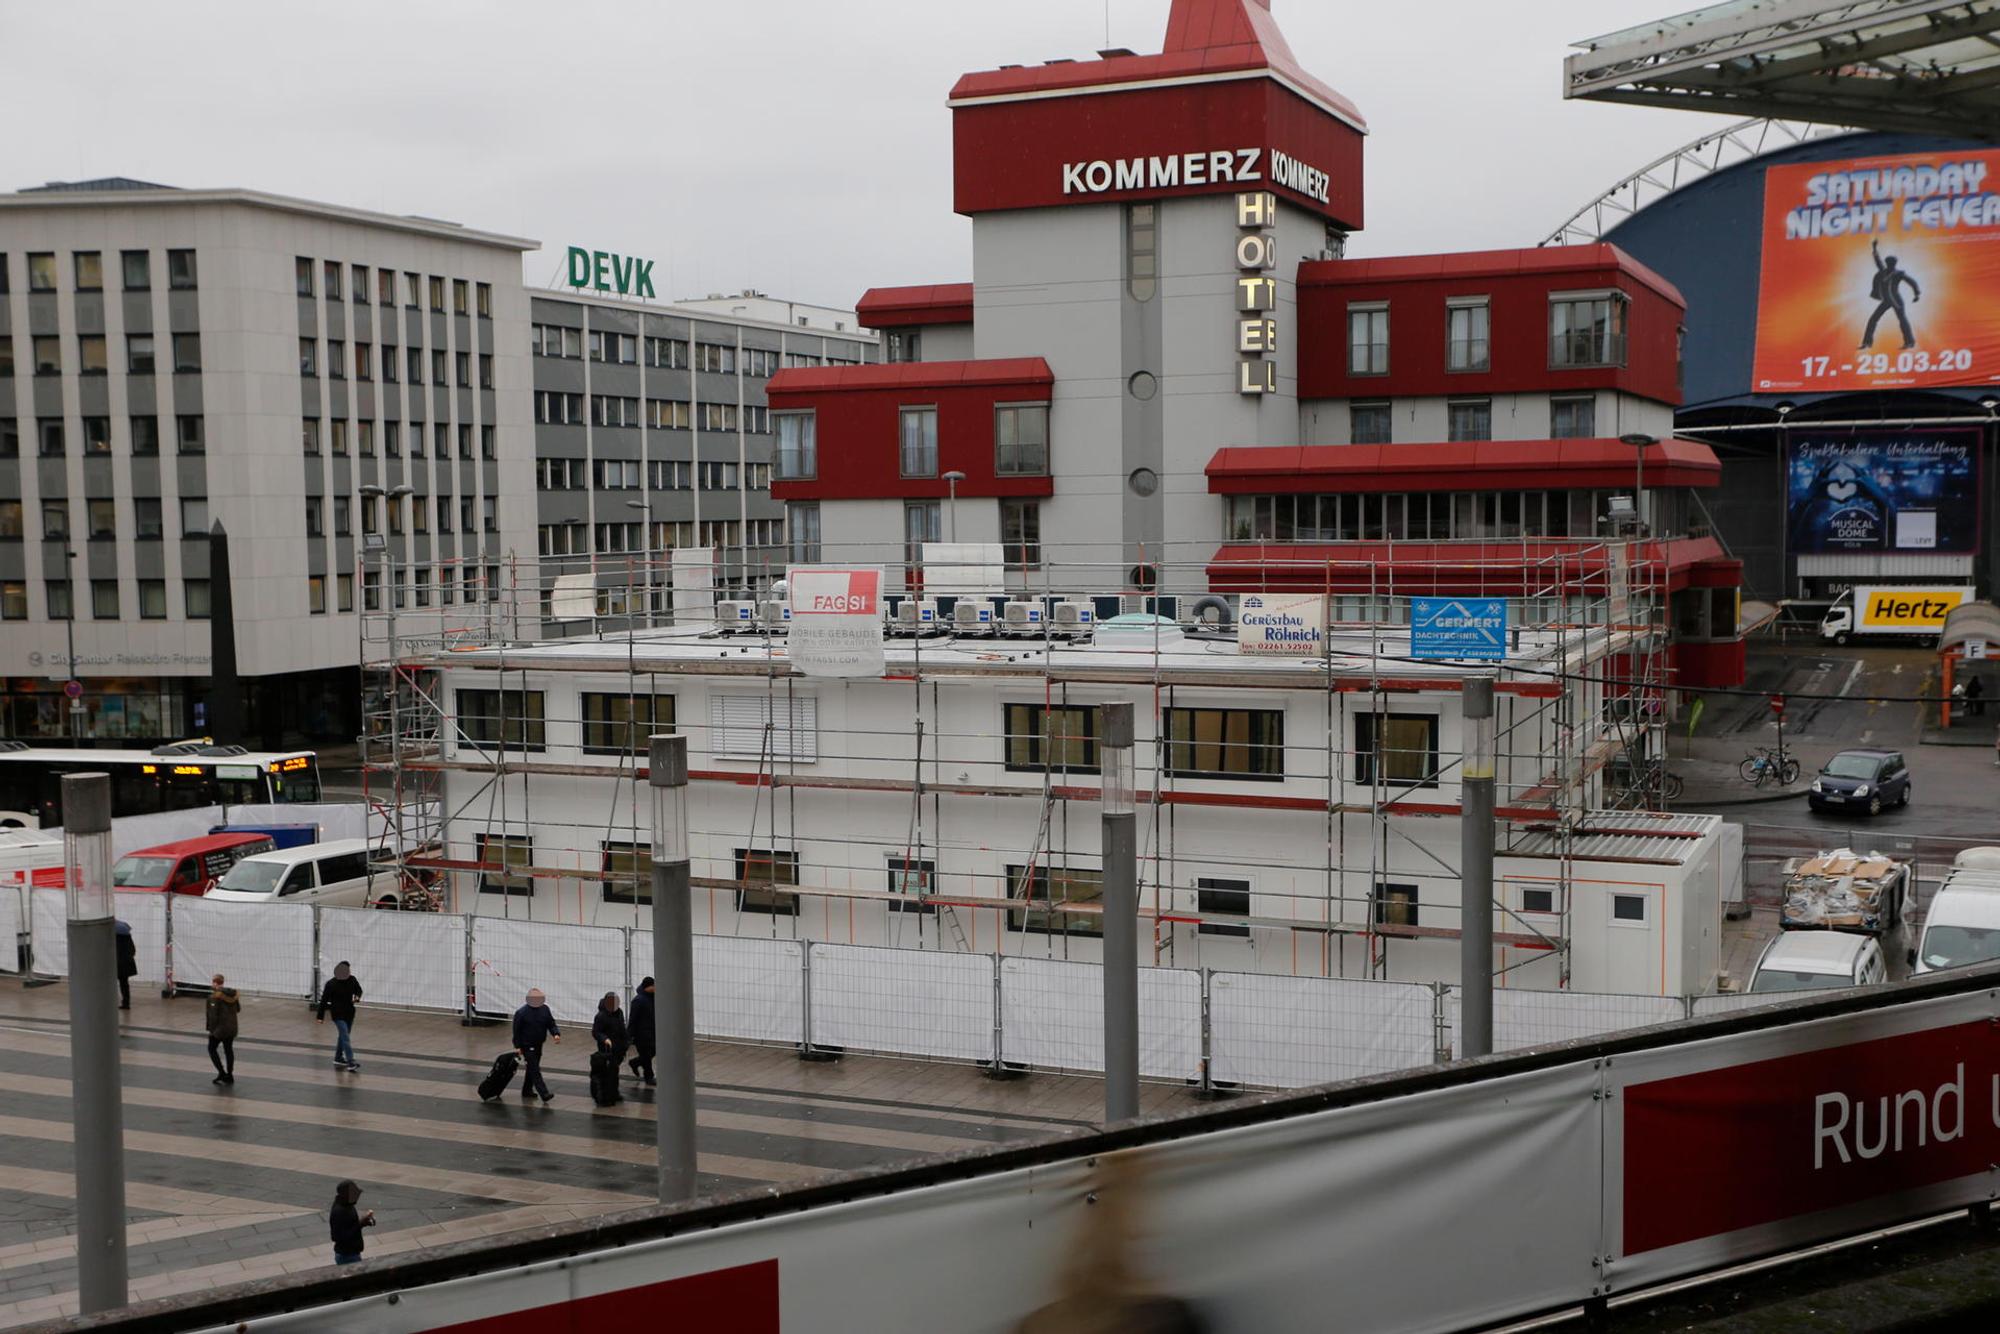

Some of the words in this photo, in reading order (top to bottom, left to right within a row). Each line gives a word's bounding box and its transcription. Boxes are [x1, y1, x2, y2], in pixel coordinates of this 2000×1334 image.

[1063, 148, 1261, 193] KOMMERZ
[1271, 148, 1330, 204] KOMMERZ
[1807, 160, 1988, 206] SATURDAY
[1785, 202, 1894, 240] NIGHT
[568, 246, 656, 299] DEVK
[1238, 193, 1265, 393] HOTEL
[1856, 349, 1973, 375] 29.03.20
[1887, 441, 1968, 460] Unterhaltung
[1831, 519, 1874, 530] MUSICAL
[1838, 528, 1868, 538] DOME
[814, 595, 866, 610] FAGSI
[1875, 599, 1948, 619] Hertz
[1435, 617, 1502, 628] GERNERT
[1971, 646, 1980, 657] F
[1815, 1062, 1964, 1169] Rund
